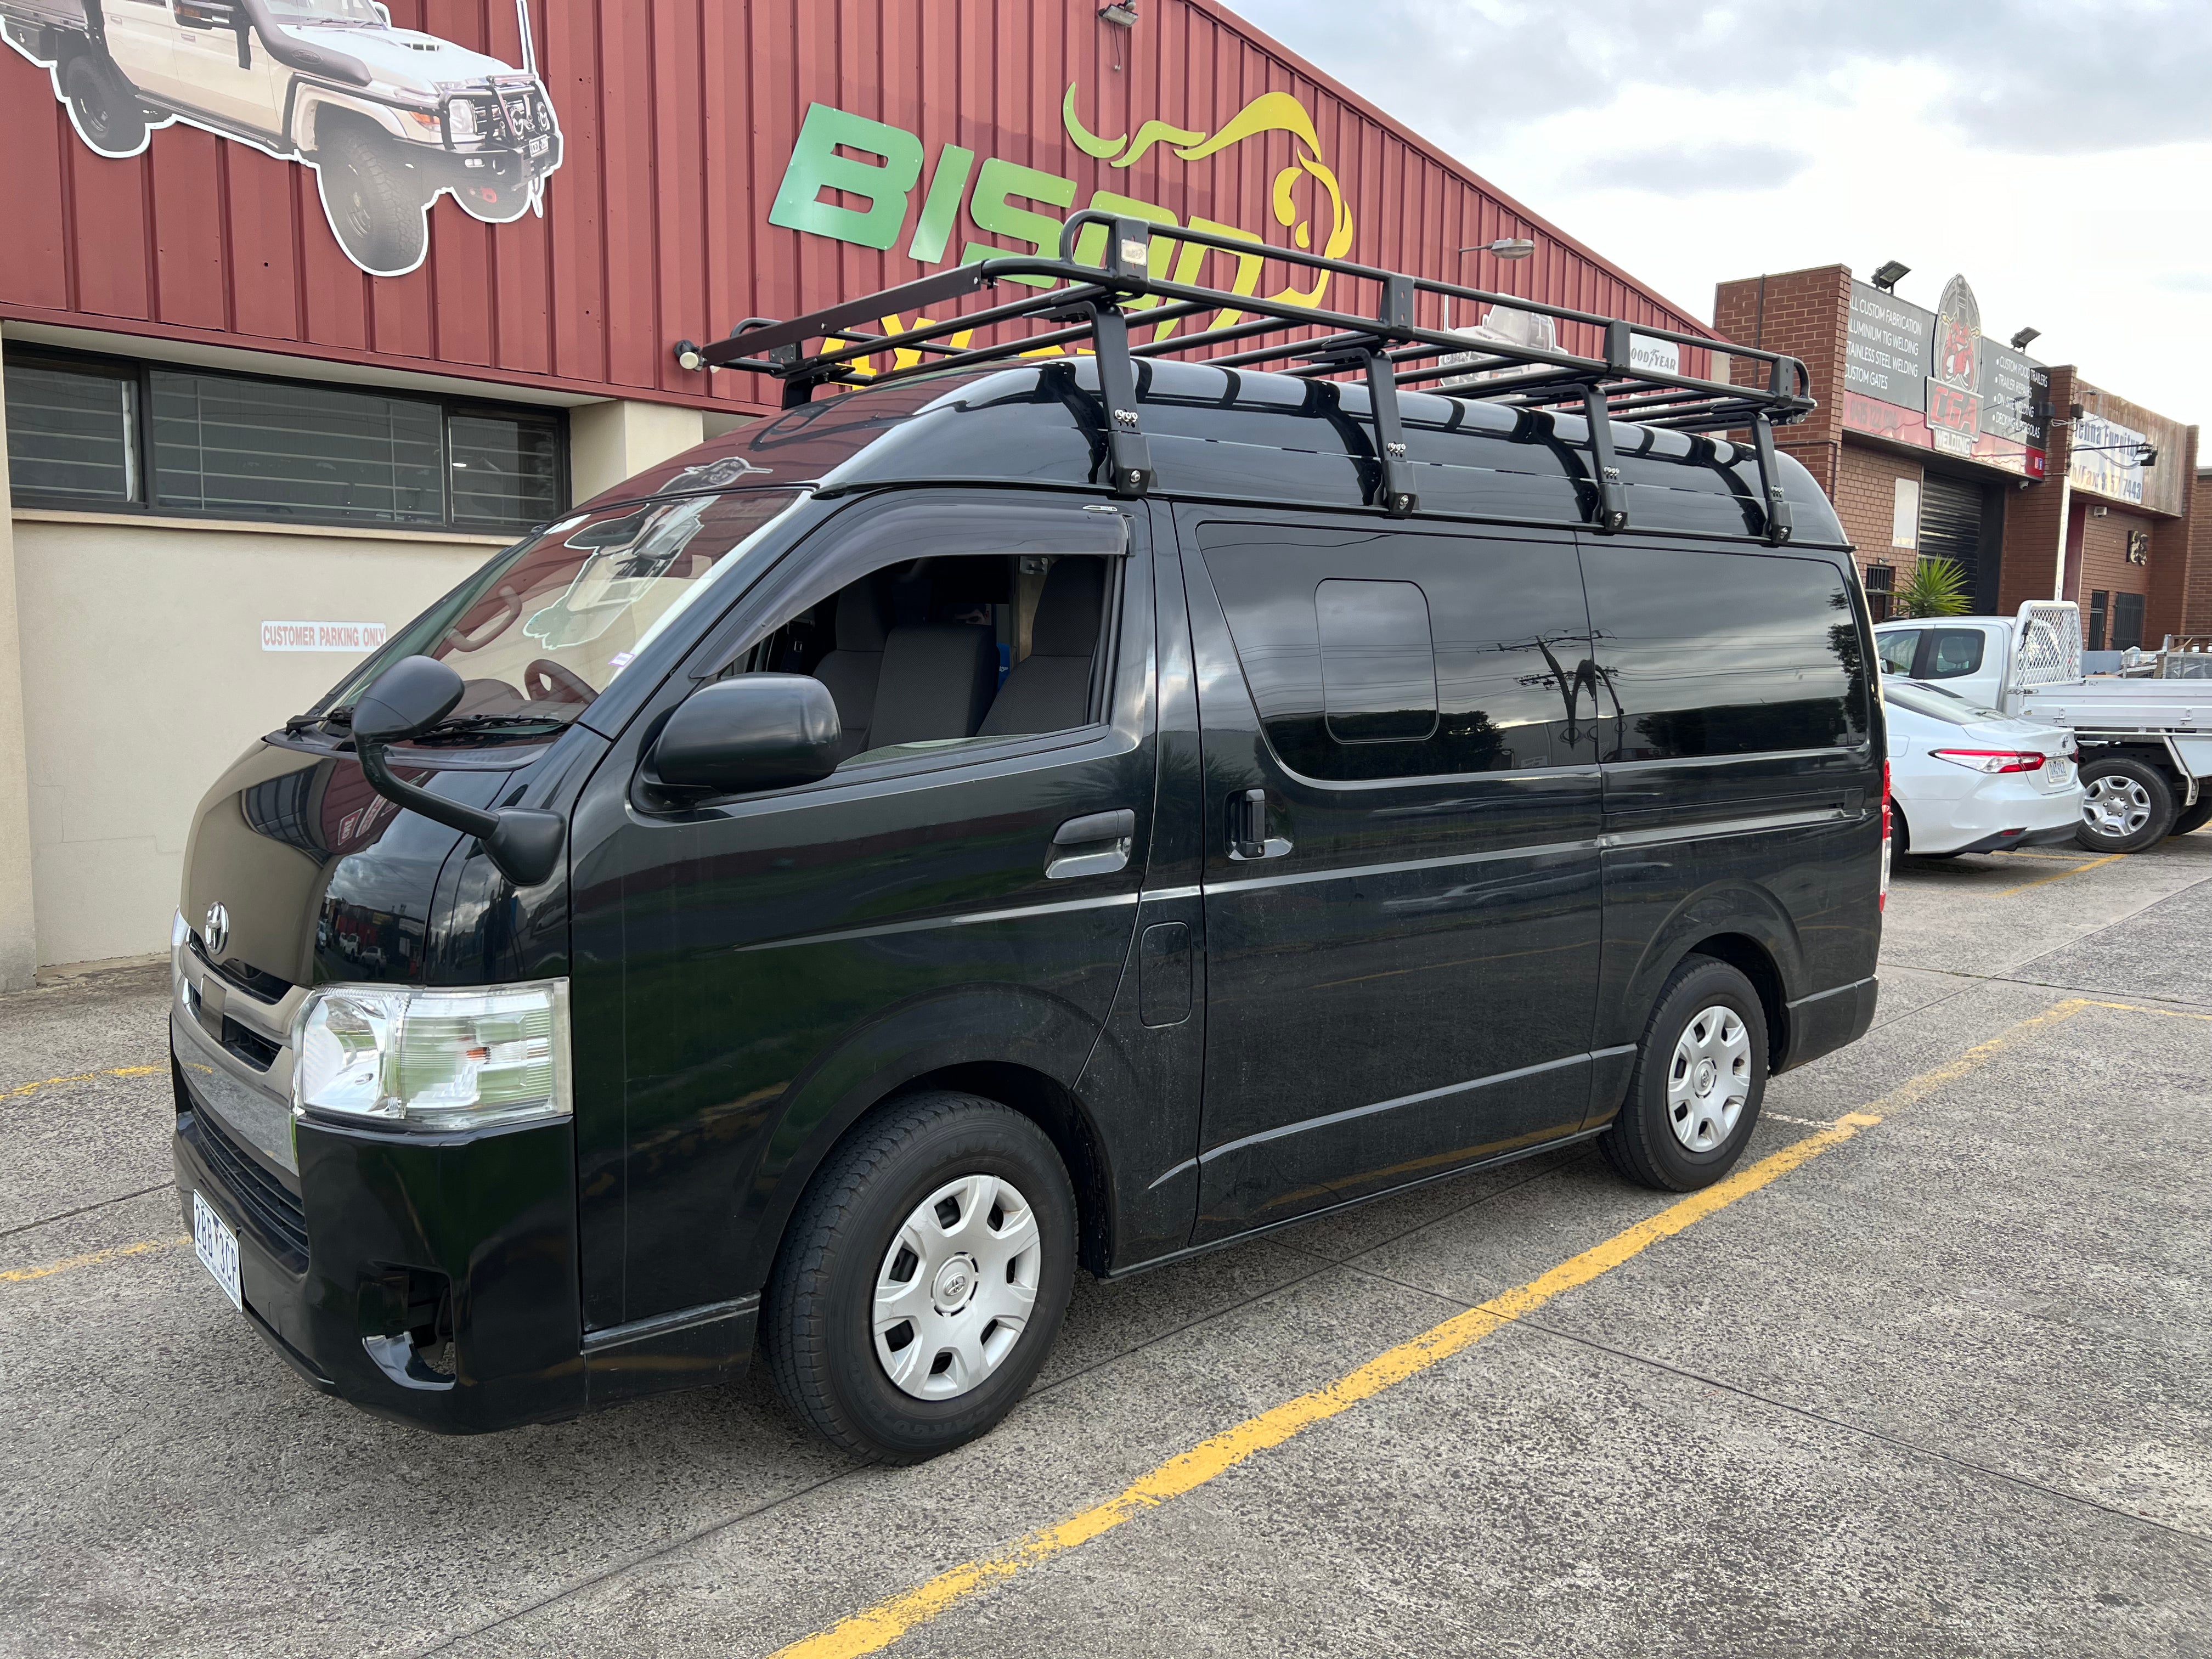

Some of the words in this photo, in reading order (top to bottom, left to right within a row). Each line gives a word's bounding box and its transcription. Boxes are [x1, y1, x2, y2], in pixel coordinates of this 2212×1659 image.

[769, 102, 1263, 342] BISON
[1860, 299, 1885, 321] CUSTOM
[1886, 310, 1922, 336] FABRICATION
[1883, 331, 1892, 346] TIG
[1893, 335, 1918, 356] WELDING
[1631, 348, 1676, 370] OODYEAR
[1876, 351, 1891, 369] STEEL
[1893, 356, 1918, 377] WELDING
[2000, 356, 2018, 374] CUSTOM
[2018, 364, 2030, 379] FOOD
[2031, 369, 2048, 387] TRAILERS
[1870, 371, 1888, 390] GATES
[1999, 374, 2015, 392] TRAILER
[2016, 381, 2032, 398] REPAIRS
[1931, 386, 1977, 435] CGA
[2015, 400, 2034, 417] WELDING
[1996, 411, 2016, 430] DECKING
[2021, 420, 2040, 438] PERGOLAS
[1936, 429, 1971, 454] WELDING
[2123, 478, 2141, 500] 7443
[263, 625, 315, 646] CUSTOMER
[319, 627, 359, 646] PARKING
[363, 627, 385, 646] ONLY
[219, 1233, 236, 1288] 3CP
